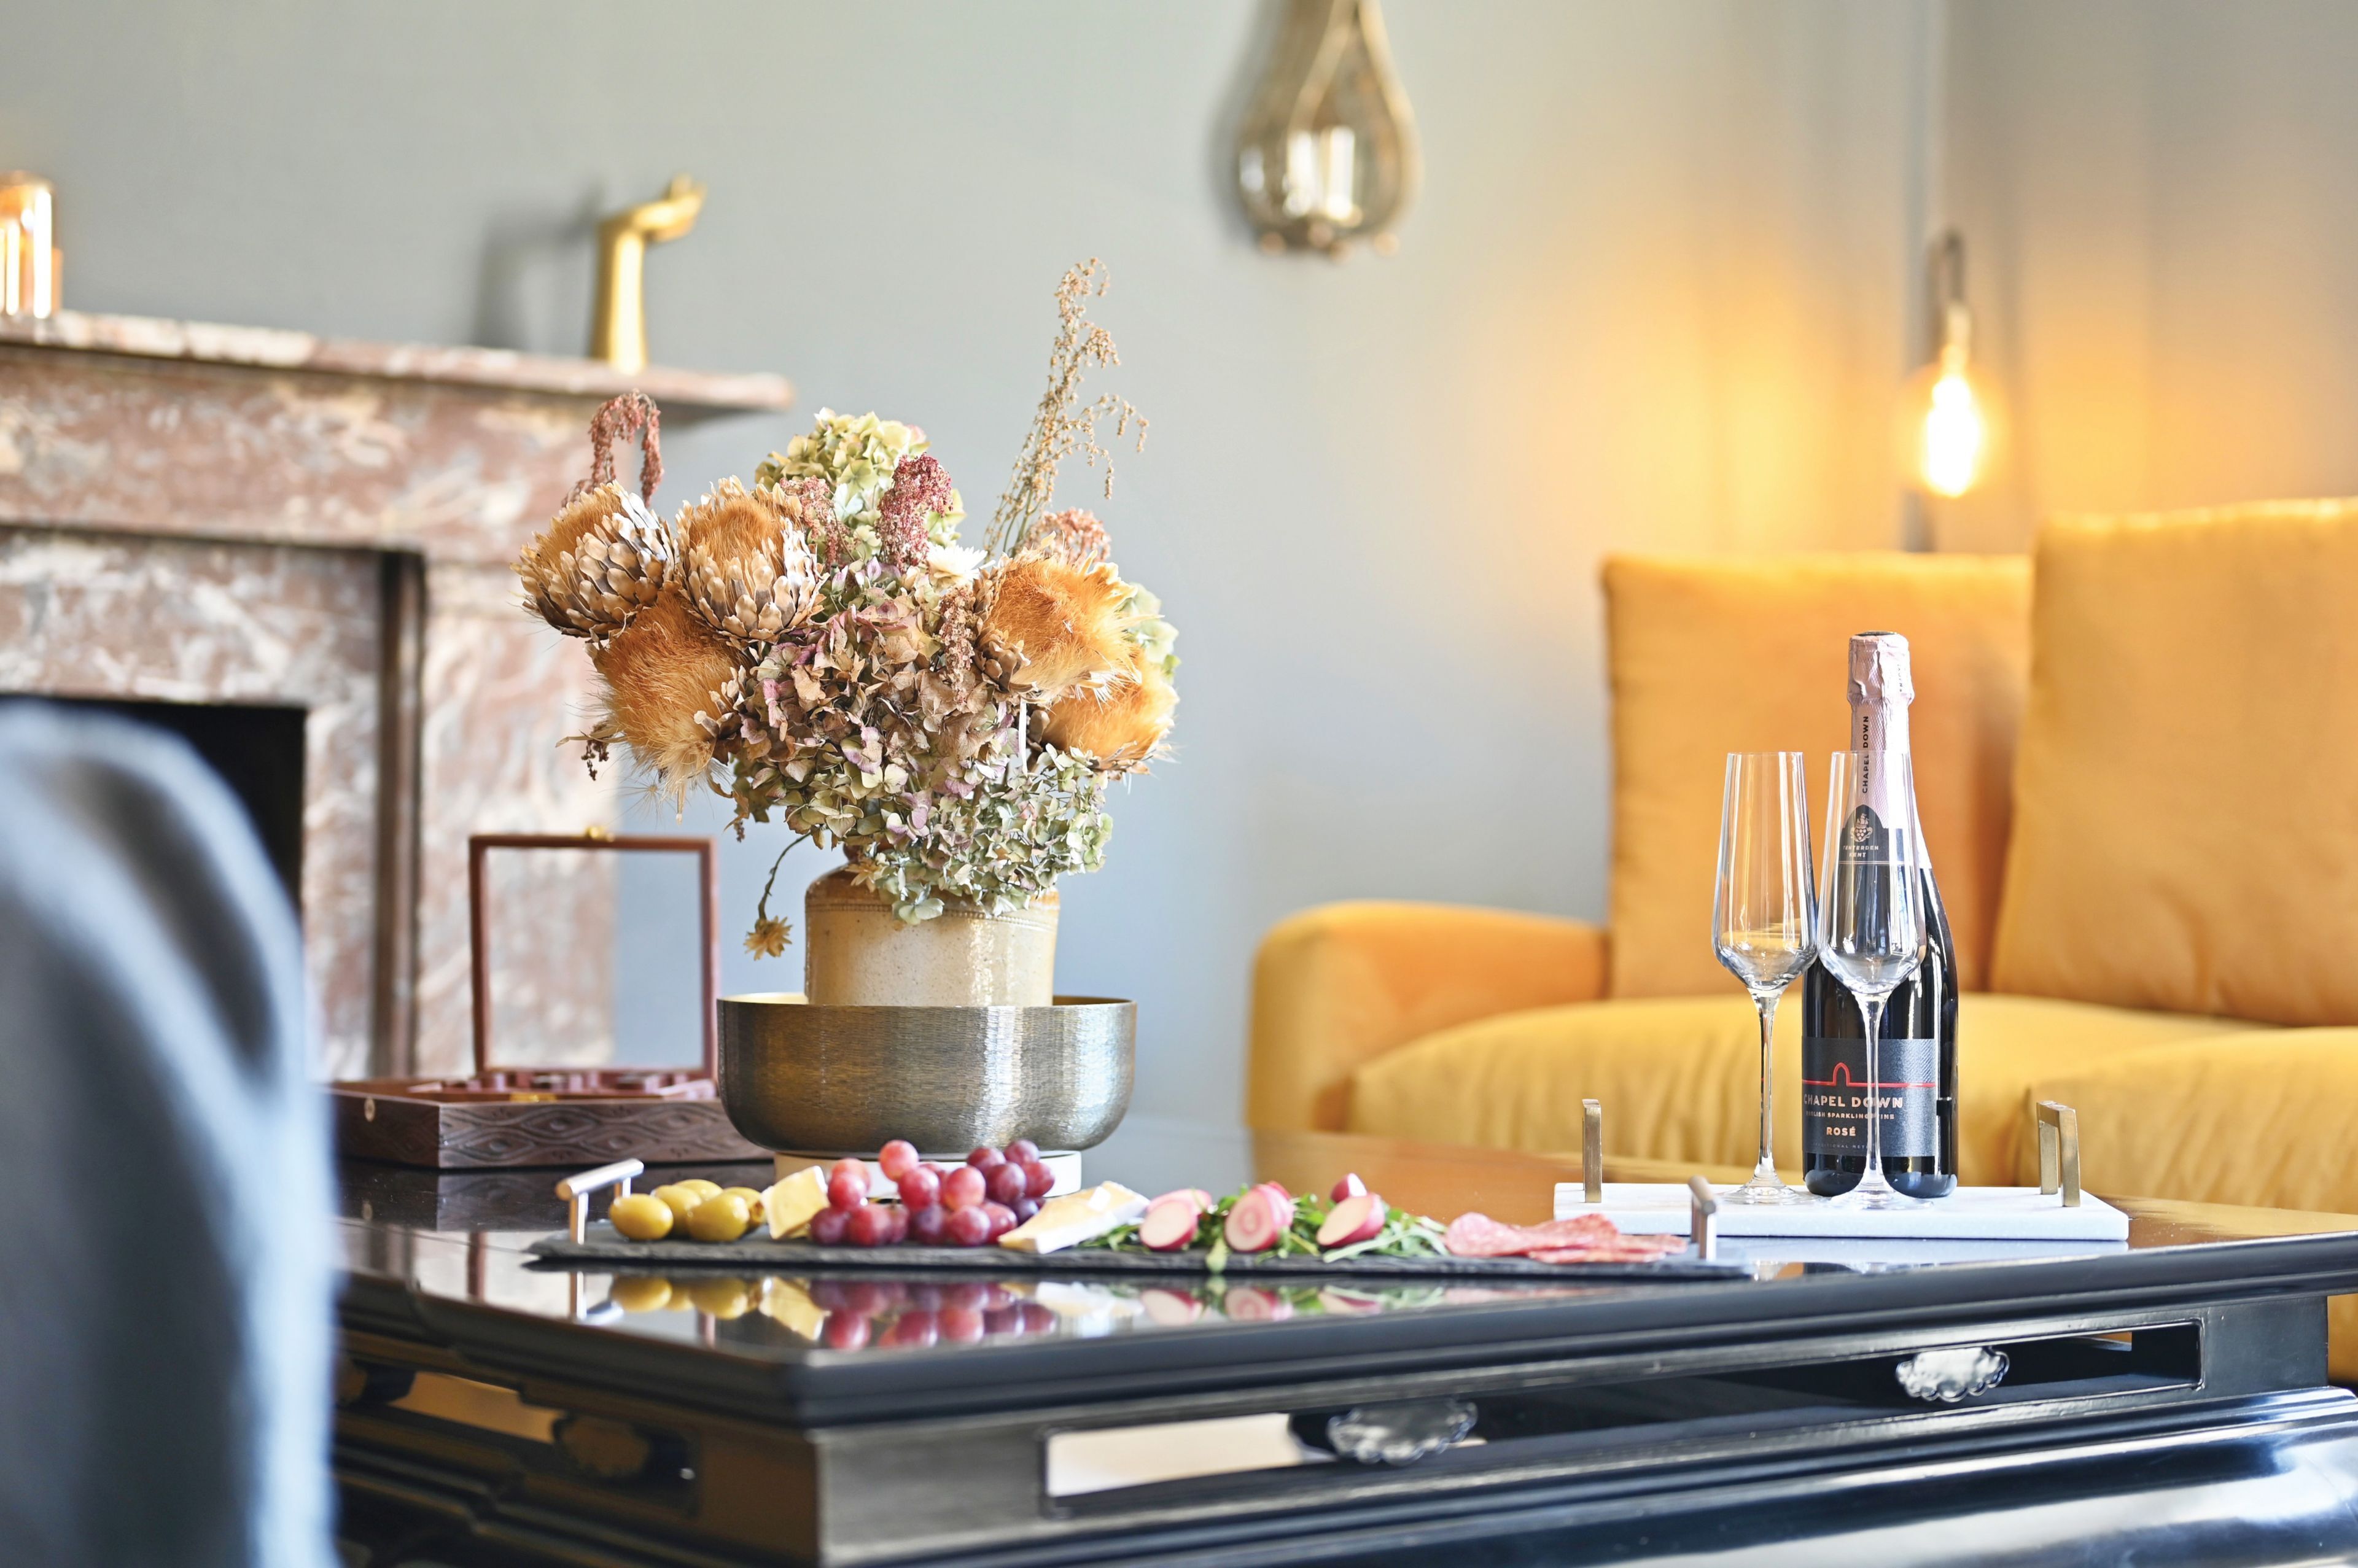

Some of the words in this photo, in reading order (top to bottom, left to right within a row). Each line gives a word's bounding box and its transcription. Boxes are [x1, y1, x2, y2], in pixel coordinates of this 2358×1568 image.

[1804, 1094, 1845, 1107] CHAPEL
[1851, 1096, 1903, 1108] DOWN
[1826, 1126, 1856, 1136] ROSÉ
